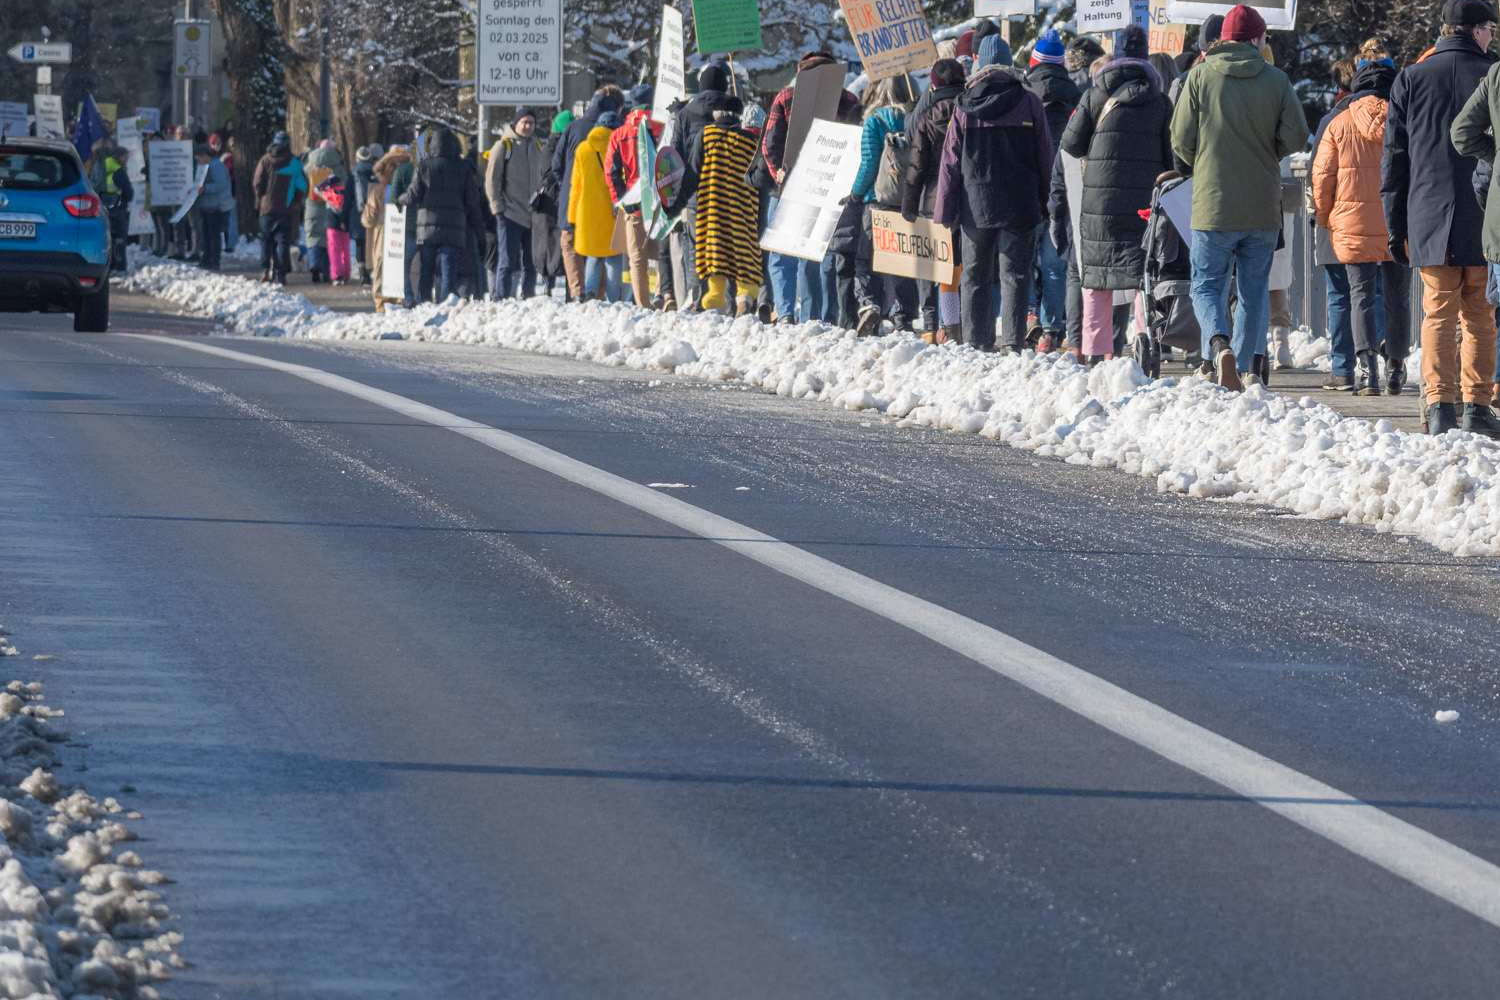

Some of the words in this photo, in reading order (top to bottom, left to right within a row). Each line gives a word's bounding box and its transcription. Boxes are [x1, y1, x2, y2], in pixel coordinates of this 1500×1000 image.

[485, 14, 531, 29] Sonntag
[534, 14, 555, 26] den
[847, 3, 878, 32] FÜR
[1084, 11, 1122, 22] Haltung
[489, 32, 549, 44] 02.03.2025
[856, 17, 931, 58] BRANDSTIFTER
[1148, 29, 1184, 53] ELLEN
[38, 48, 62, 57] Casino
[498, 51, 521, 62] von
[524, 52, 543, 62] ca.
[489, 68, 521, 80] 12-18
[526, 68, 550, 80] Uhr
[482, 84, 557, 97] Narrensprung
[817, 153, 830, 164] auf
[804, 181, 830, 197] Dächer
[873, 213, 882, 227] Ich
[882, 213, 892, 229] bin
[14, 224, 35, 235] 999
